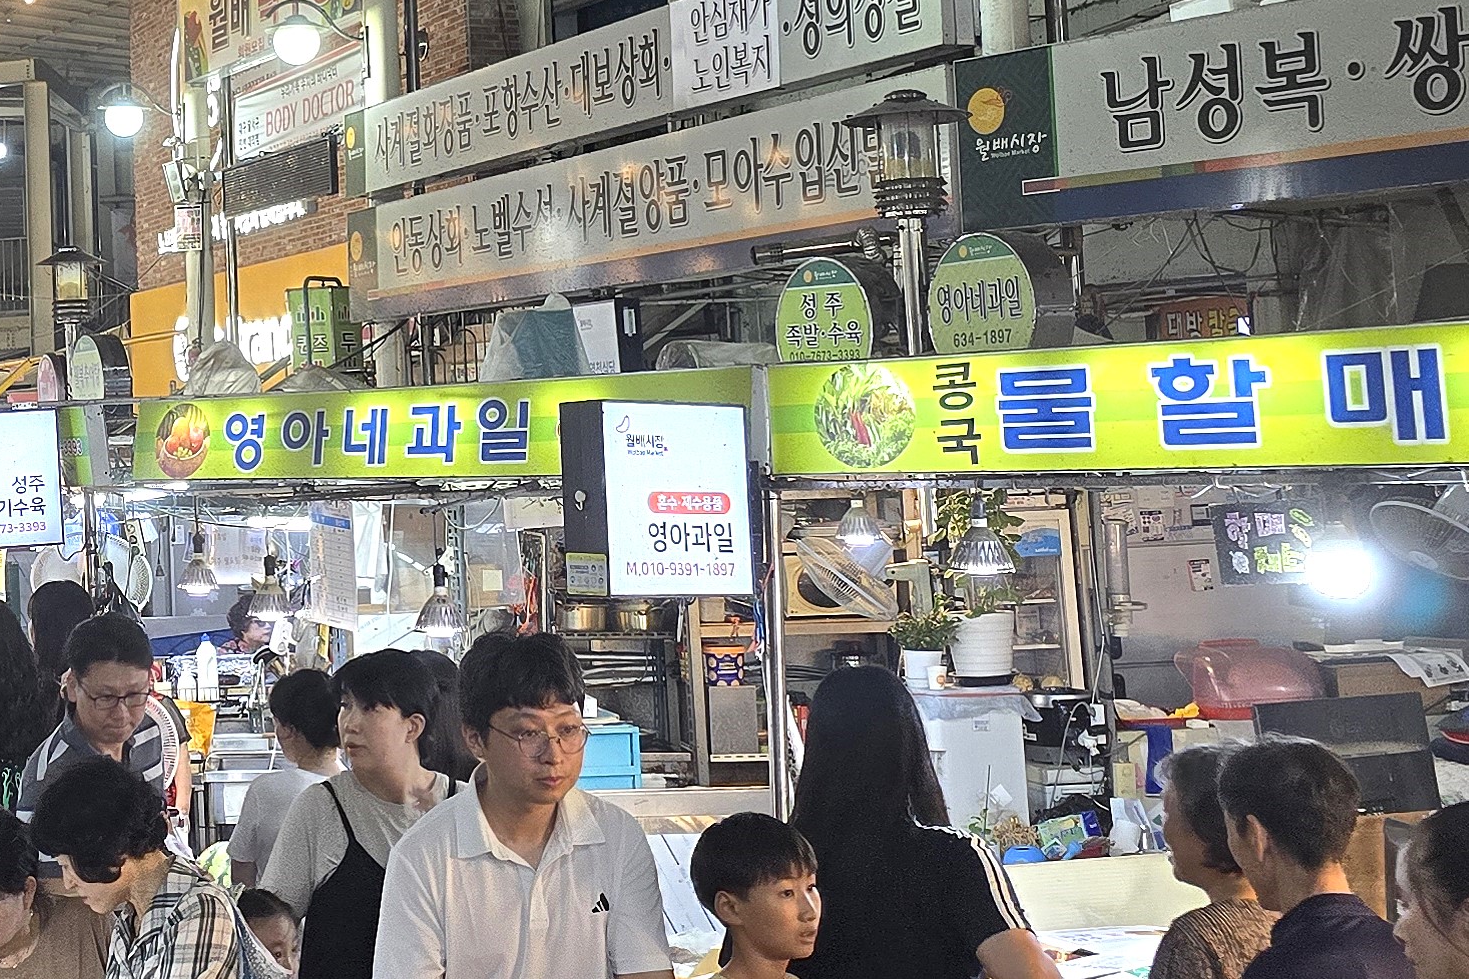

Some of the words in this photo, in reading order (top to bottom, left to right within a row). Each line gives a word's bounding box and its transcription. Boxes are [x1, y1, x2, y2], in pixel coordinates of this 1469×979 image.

[691, 34, 772, 93] 노인복지
[265, 101, 298, 138] BODY
[302, 78, 356, 125] DOCTOR
[975, 131, 1048, 162] 월배시장
[936, 276, 1023, 326] 영아네과일
[952, 329, 1012, 348] 634-1897
[1166, 310, 1203, 338] 대방
[932, 361, 982, 465] 콩국
[223, 399, 530, 473] 영아네과일
[11, 474, 46, 495] 성주
[647, 521, 734, 553] 영아과일
[626, 561, 736, 577] M.010-9391-1897
